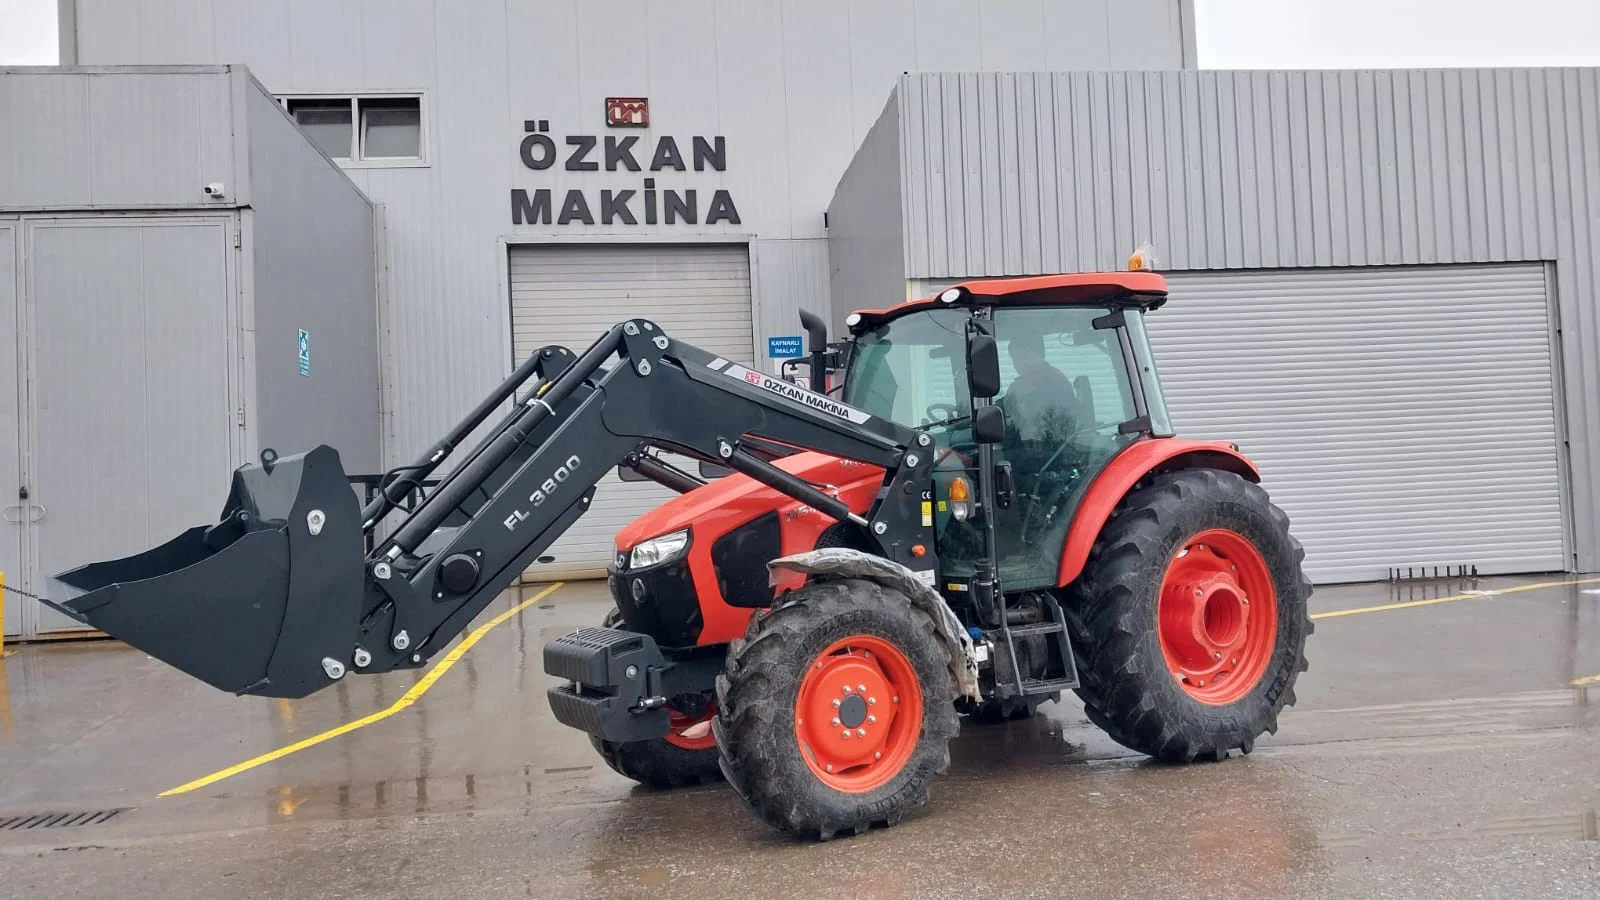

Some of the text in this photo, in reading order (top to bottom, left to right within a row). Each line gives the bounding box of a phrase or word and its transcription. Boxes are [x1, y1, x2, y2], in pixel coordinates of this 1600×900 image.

[519, 120, 726, 171] ÖZKAN
[511, 178, 741, 224] MAKİNA
[503, 455, 581, 531] FL 3800
